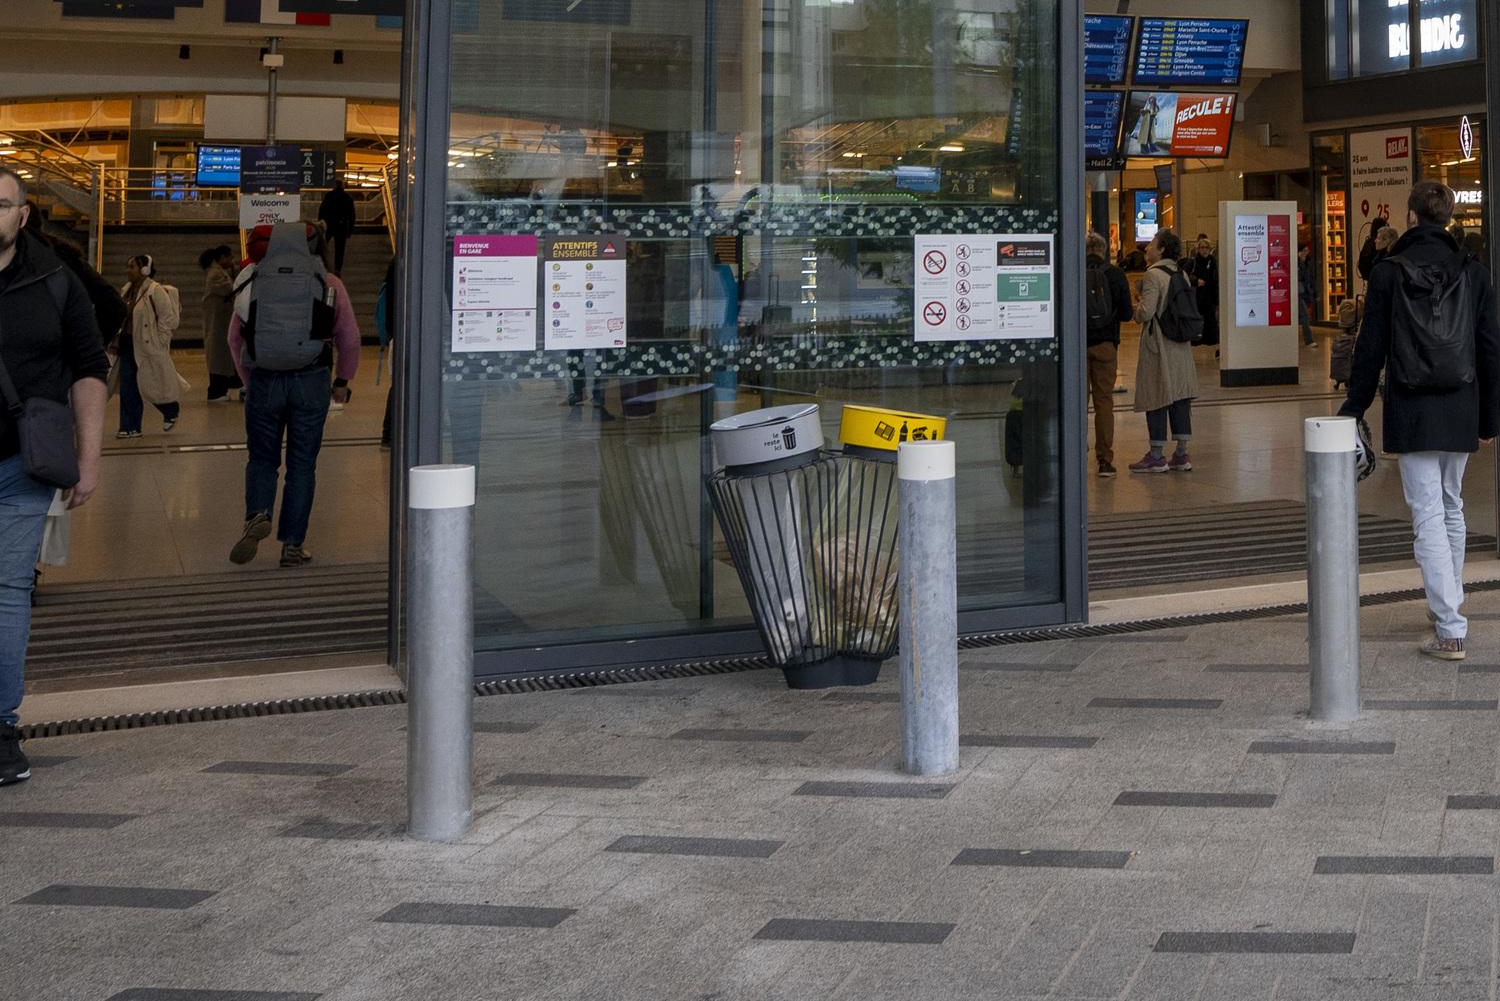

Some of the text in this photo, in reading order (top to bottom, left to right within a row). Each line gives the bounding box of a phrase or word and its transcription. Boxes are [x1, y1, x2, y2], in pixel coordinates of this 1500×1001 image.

[1388, 13, 1465, 58] BLNDIE
[1223, 23, 1240, 78] départs
[1175, 96, 1224, 124] RECULE
[1099, 101, 1115, 156] départs
[1387, 137, 1408, 156] RELAY
[250, 199, 290, 208] Welcome
[552, 241, 598, 250] ATTENTIFS
[552, 249, 598, 258] ENSEMBLE
